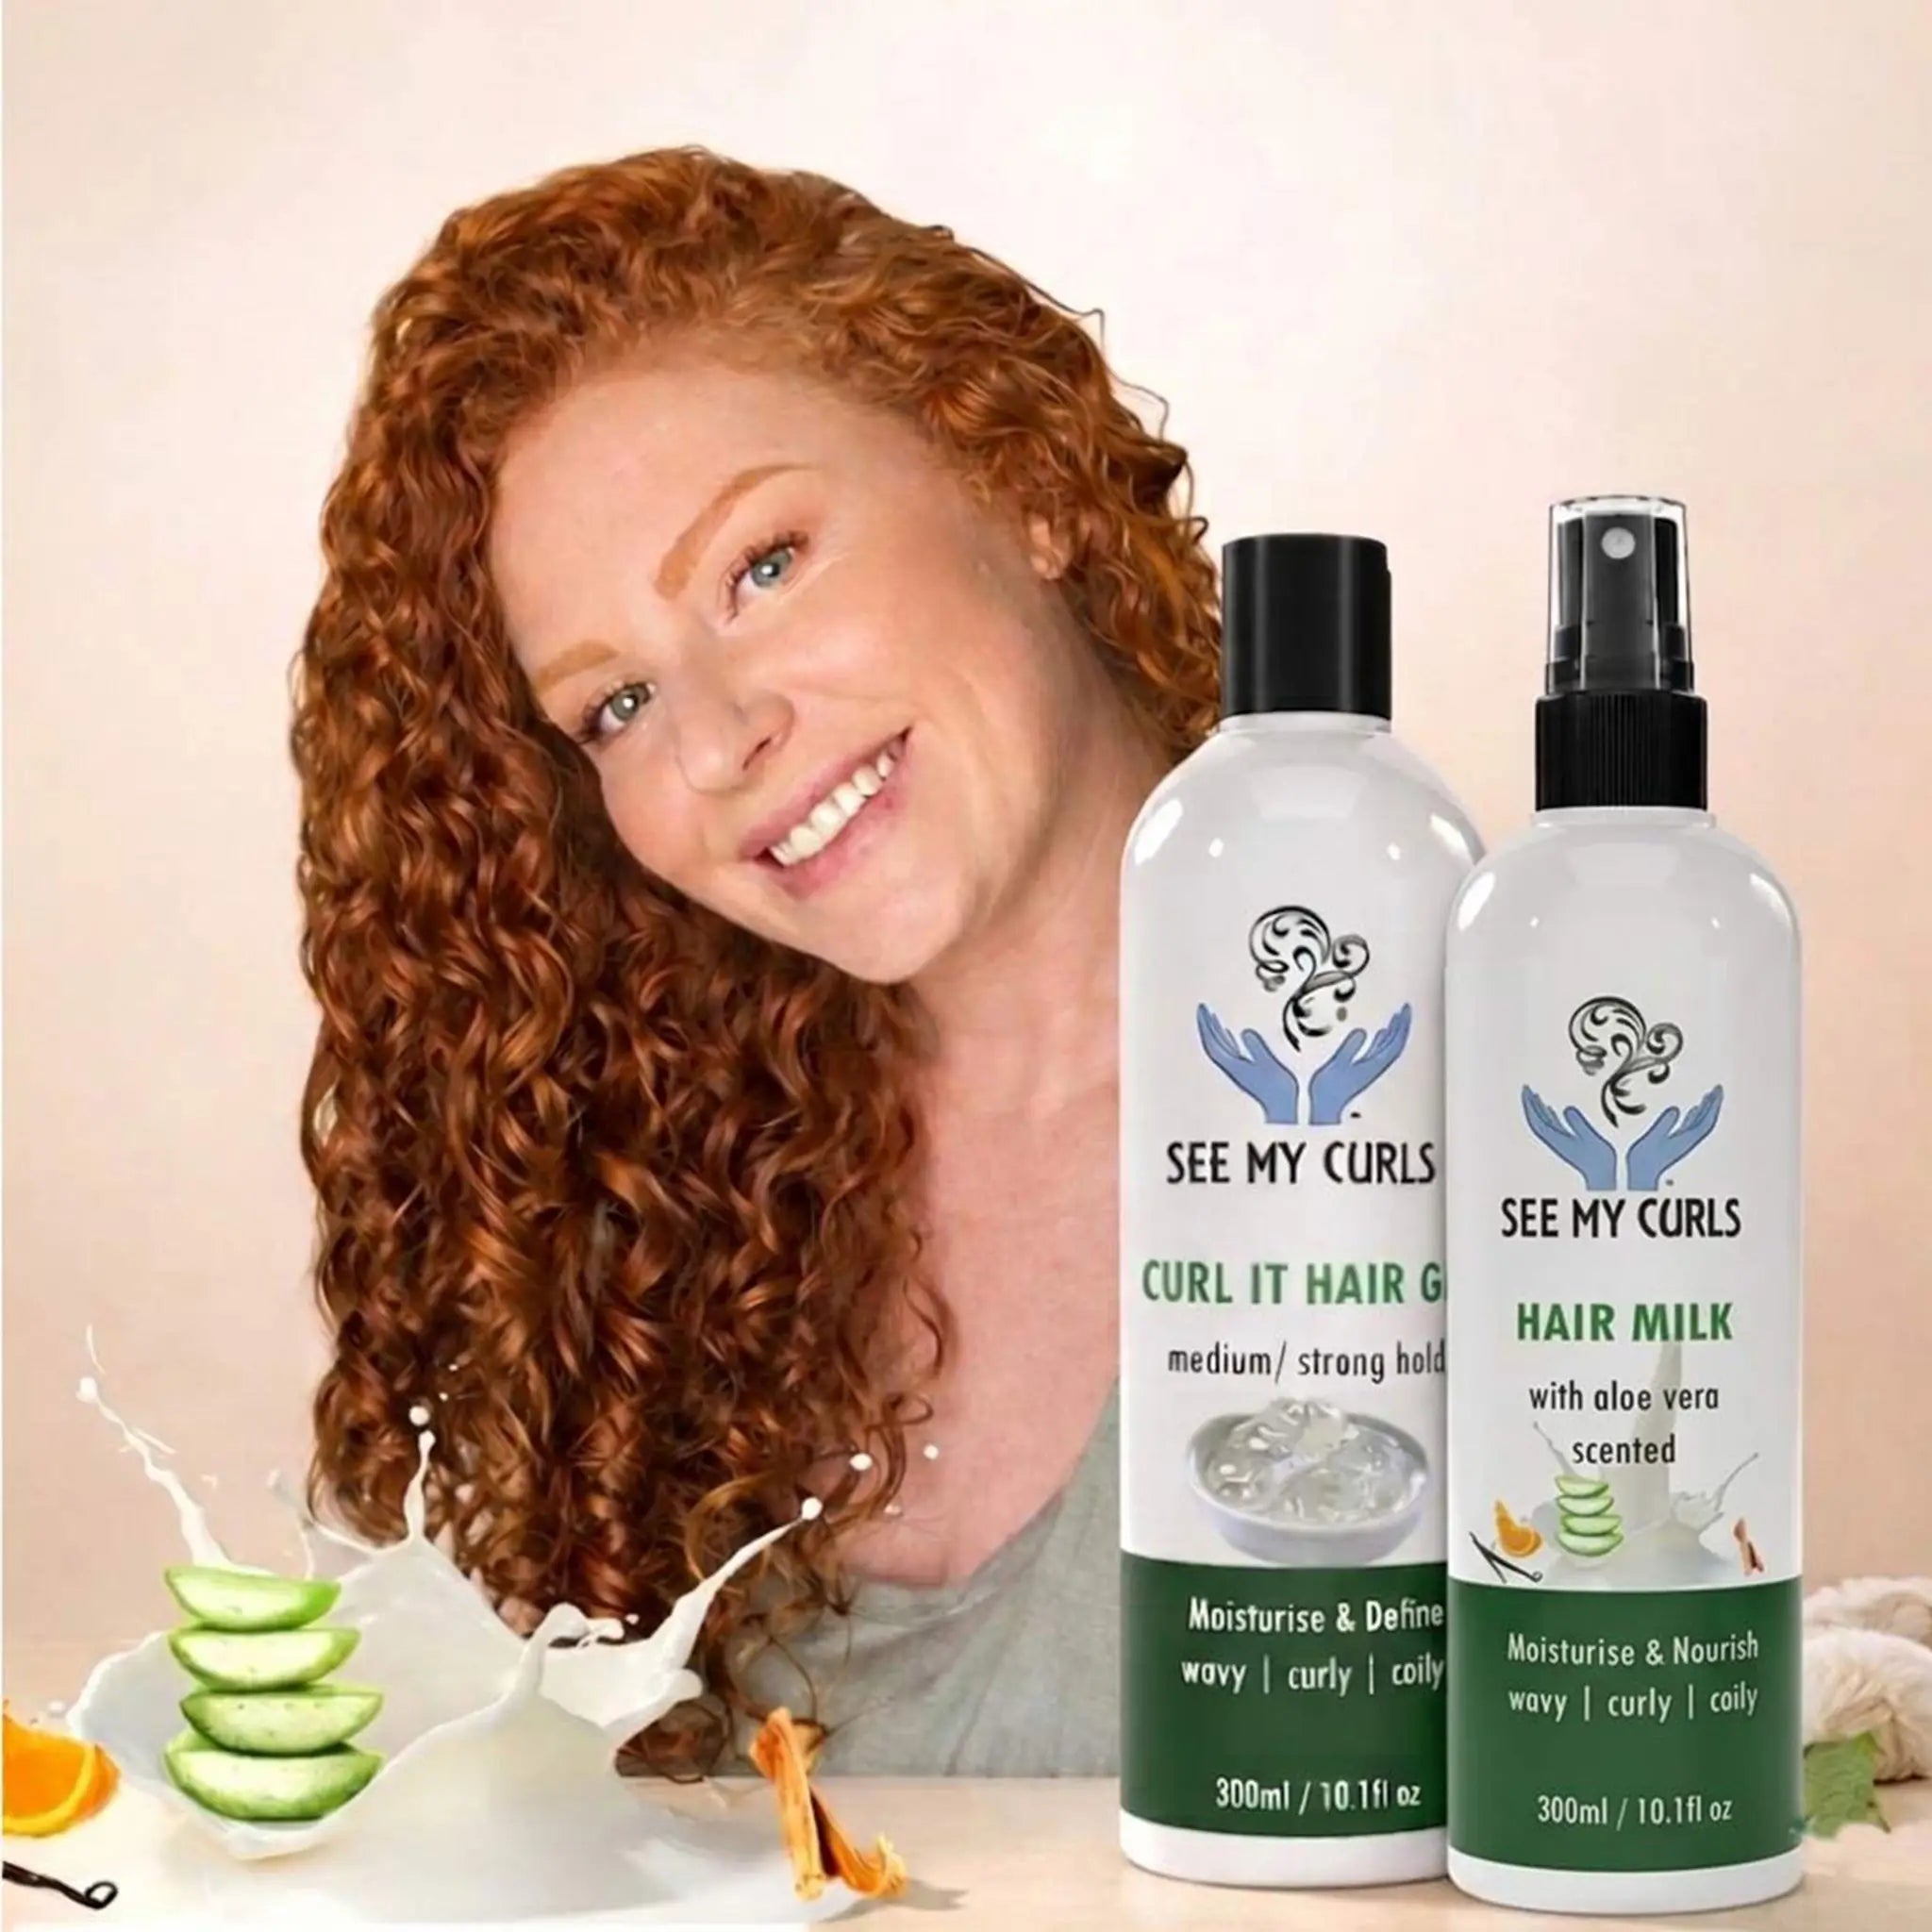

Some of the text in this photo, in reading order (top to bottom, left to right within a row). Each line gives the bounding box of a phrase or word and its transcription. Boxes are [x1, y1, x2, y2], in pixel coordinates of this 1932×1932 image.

[1166, 1141, 1436, 1184] SEE MY CURLS
[1501, 1198, 1741, 1239] SEE MY CURLS
[1142, 1260, 1233, 1304] CURL
[1251, 1264, 1288, 1305] IT
[1307, 1263, 1405, 1305] HAIR
[1518, 1303, 1733, 1341] HAIR MILK
[1299, 1349, 1385, 1384] strong
[1397, 1341, 1446, 1374] hold
[1530, 1380, 1719, 1410] with aloe vera
[1573, 1433, 1675, 1464] scented
[1189, 1596, 1444, 1633] Moisturise & Define
[1507, 1630, 1758, 1666] Moisturise & Nourish
[1181, 1661, 1246, 1694] wavy
[1289, 1657, 1352, 1697] curly
[1391, 1652, 1444, 1690] coily
[1508, 1690, 1568, 1723] wavy
[1608, 1688, 1672, 1724] curly
[1710, 1681, 1757, 1716] coily
[1216, 1777, 1289, 1810] 300ml
[1320, 1778, 1388, 1811] 10.1fl
[1397, 1785, 1421, 1806] oz
[1538, 1795, 1607, 1824] 300ml
[1639, 1795, 1702, 1824] 10.1fl
[1710, 1800, 1733, 1821] oz
